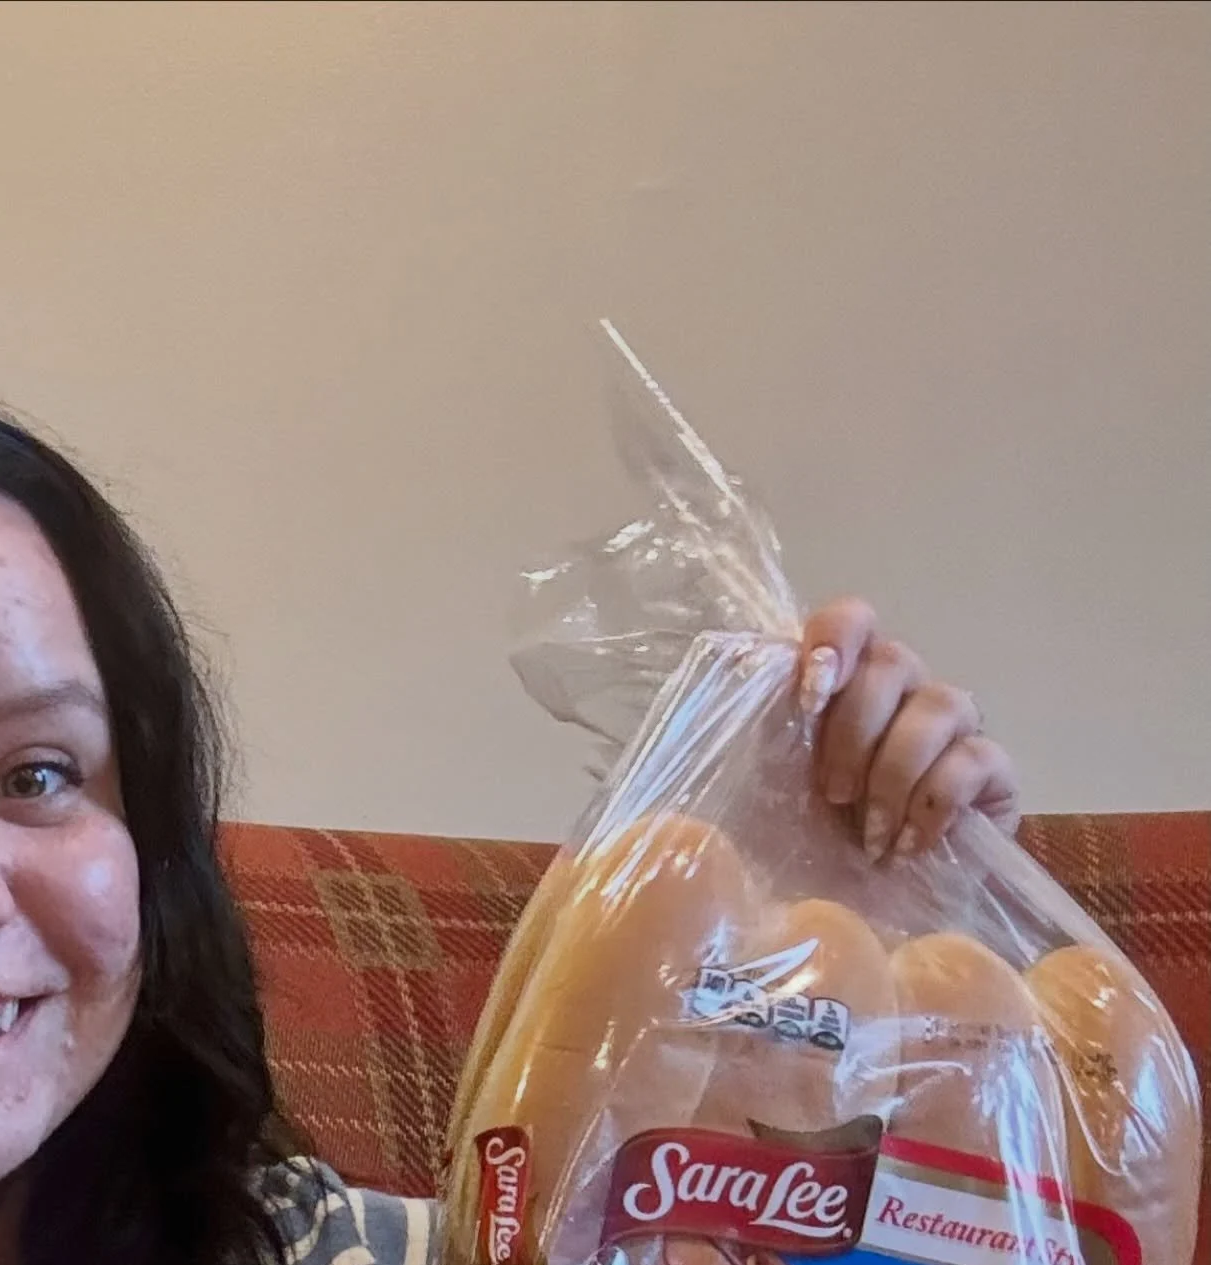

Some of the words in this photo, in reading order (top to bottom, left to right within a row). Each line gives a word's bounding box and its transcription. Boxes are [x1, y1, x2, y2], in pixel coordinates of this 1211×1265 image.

[485, 1137, 526, 1218] Sara
[623, 1142, 759, 1221] Sara
[750, 1161, 852, 1239] Lee
